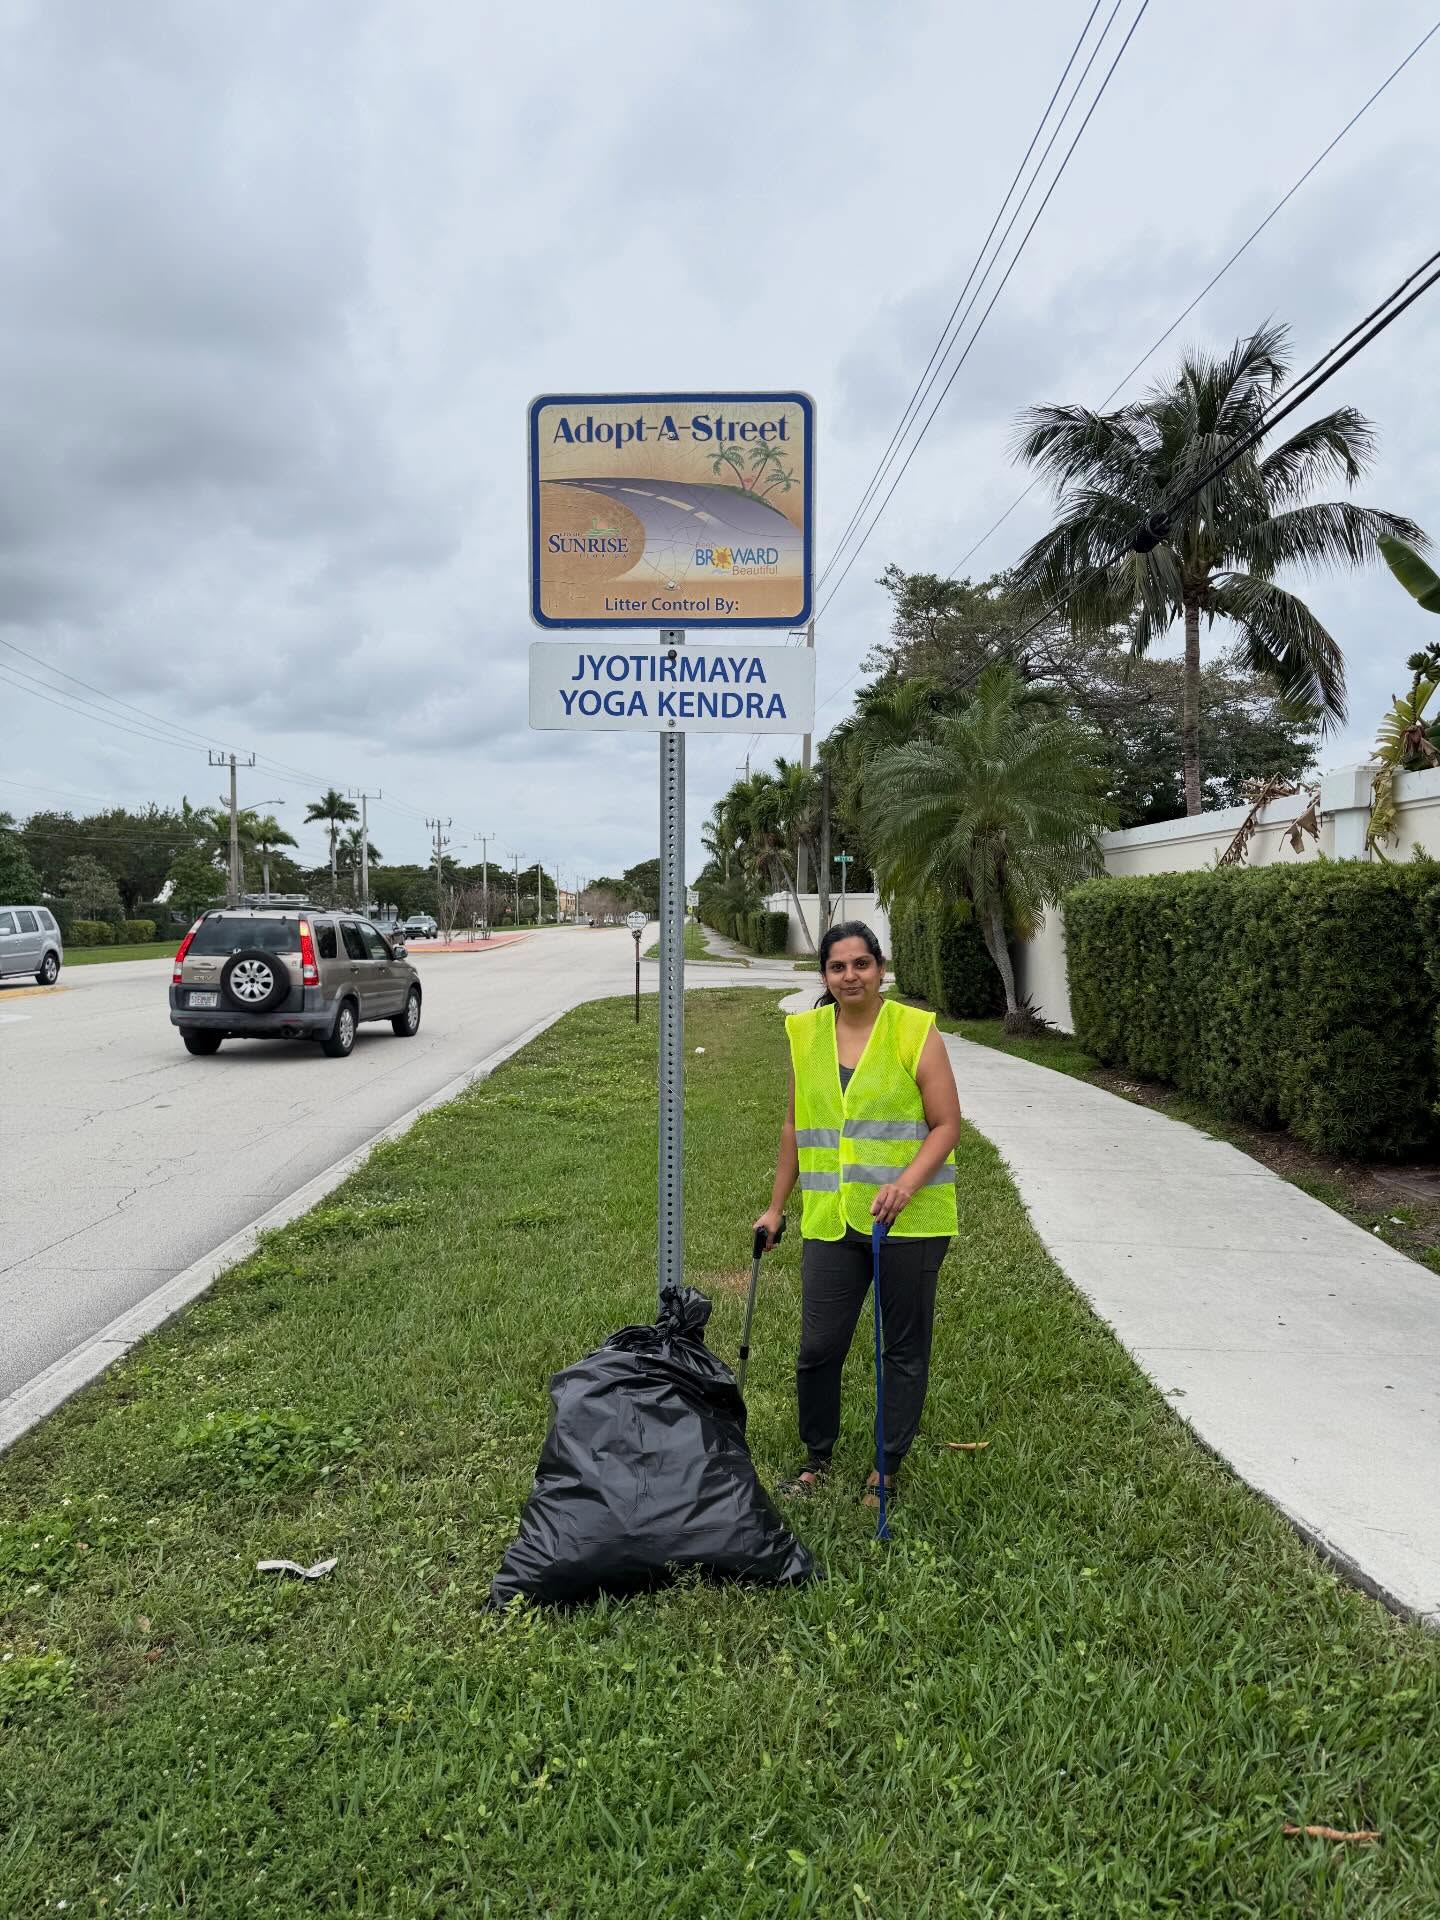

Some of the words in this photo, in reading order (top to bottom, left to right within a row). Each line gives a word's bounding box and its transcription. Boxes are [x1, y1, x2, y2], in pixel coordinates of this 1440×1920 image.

[553, 415, 790, 449] Adopt-A-Street
[548, 534, 629, 553] SUNRISE
[732, 565, 778, 576] Beautiful
[605, 597, 647, 612] Litter
[652, 596, 711, 612] Control
[715, 597, 739, 614] By:
[571, 654, 767, 683] JYOTIRMAYA
[559, 689, 648, 717] YOGA
[658, 691, 787, 719] KENDRA
